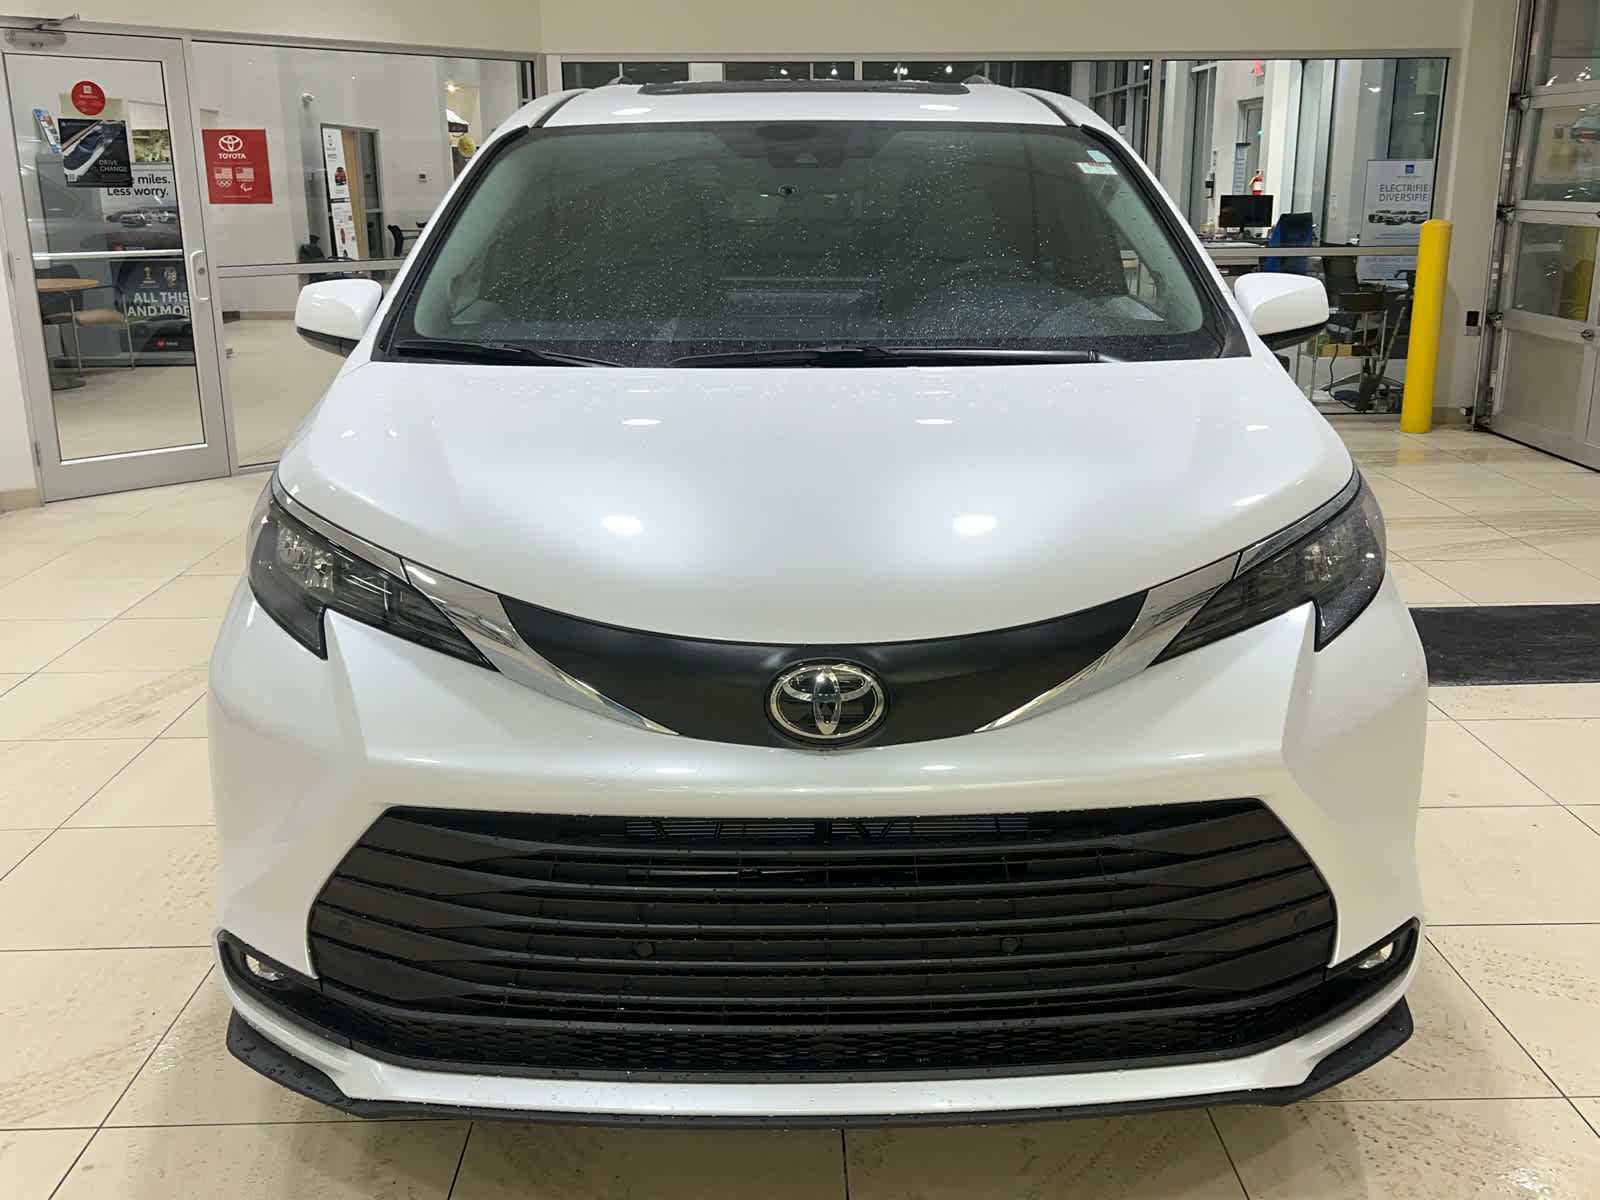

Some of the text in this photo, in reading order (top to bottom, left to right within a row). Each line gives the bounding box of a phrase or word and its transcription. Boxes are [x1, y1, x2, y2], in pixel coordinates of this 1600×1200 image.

[137, 173, 171, 184] miles.
[106, 187, 169, 198] Less worry.
[1379, 184, 1432, 193] ELECTRIFIE
[1379, 193, 1431, 202] DIVERSIFIE
[133, 291, 189, 303] ALL THIS
[127, 306, 157, 317] AND
